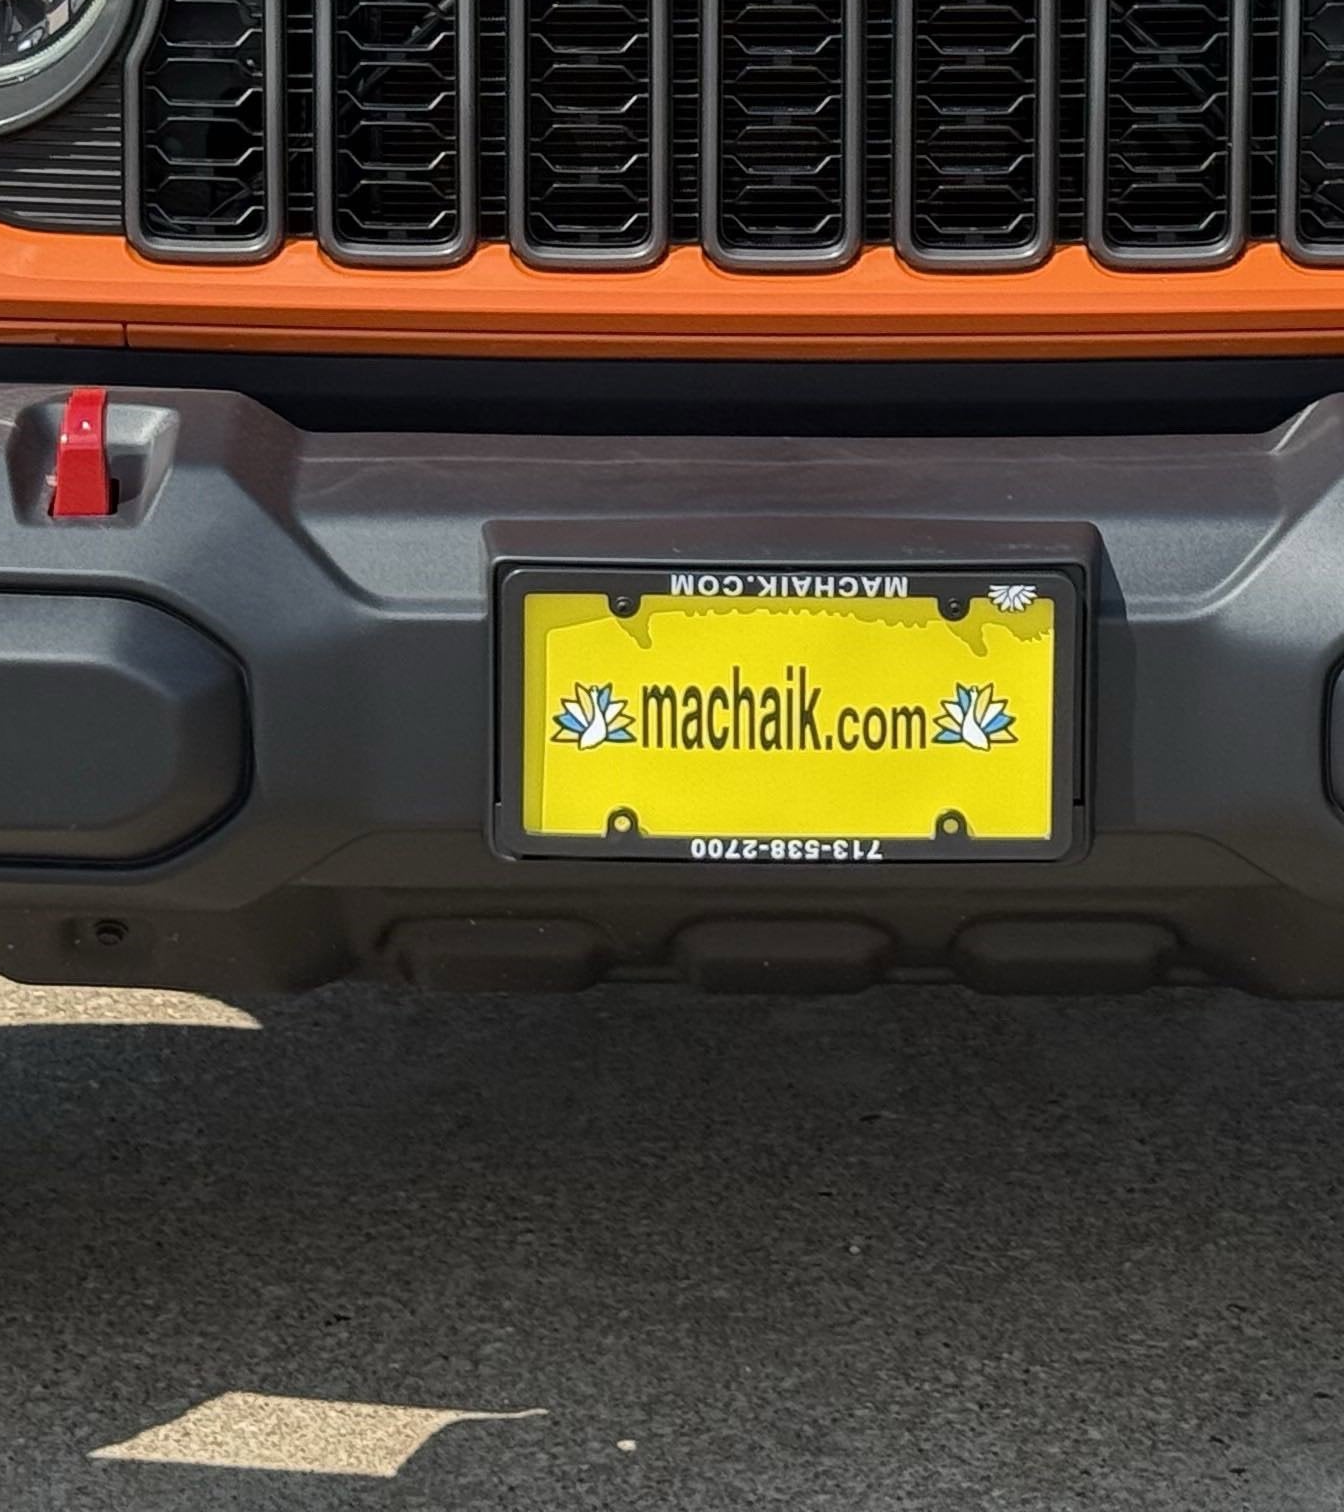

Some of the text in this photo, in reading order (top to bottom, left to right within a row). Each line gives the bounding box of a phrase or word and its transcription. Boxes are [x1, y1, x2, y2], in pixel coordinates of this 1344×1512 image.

[669, 574, 909, 598] MACHAIK.COM
[640, 665, 928, 751] machaik.com
[690, 838, 884, 861] 713-538-2700
